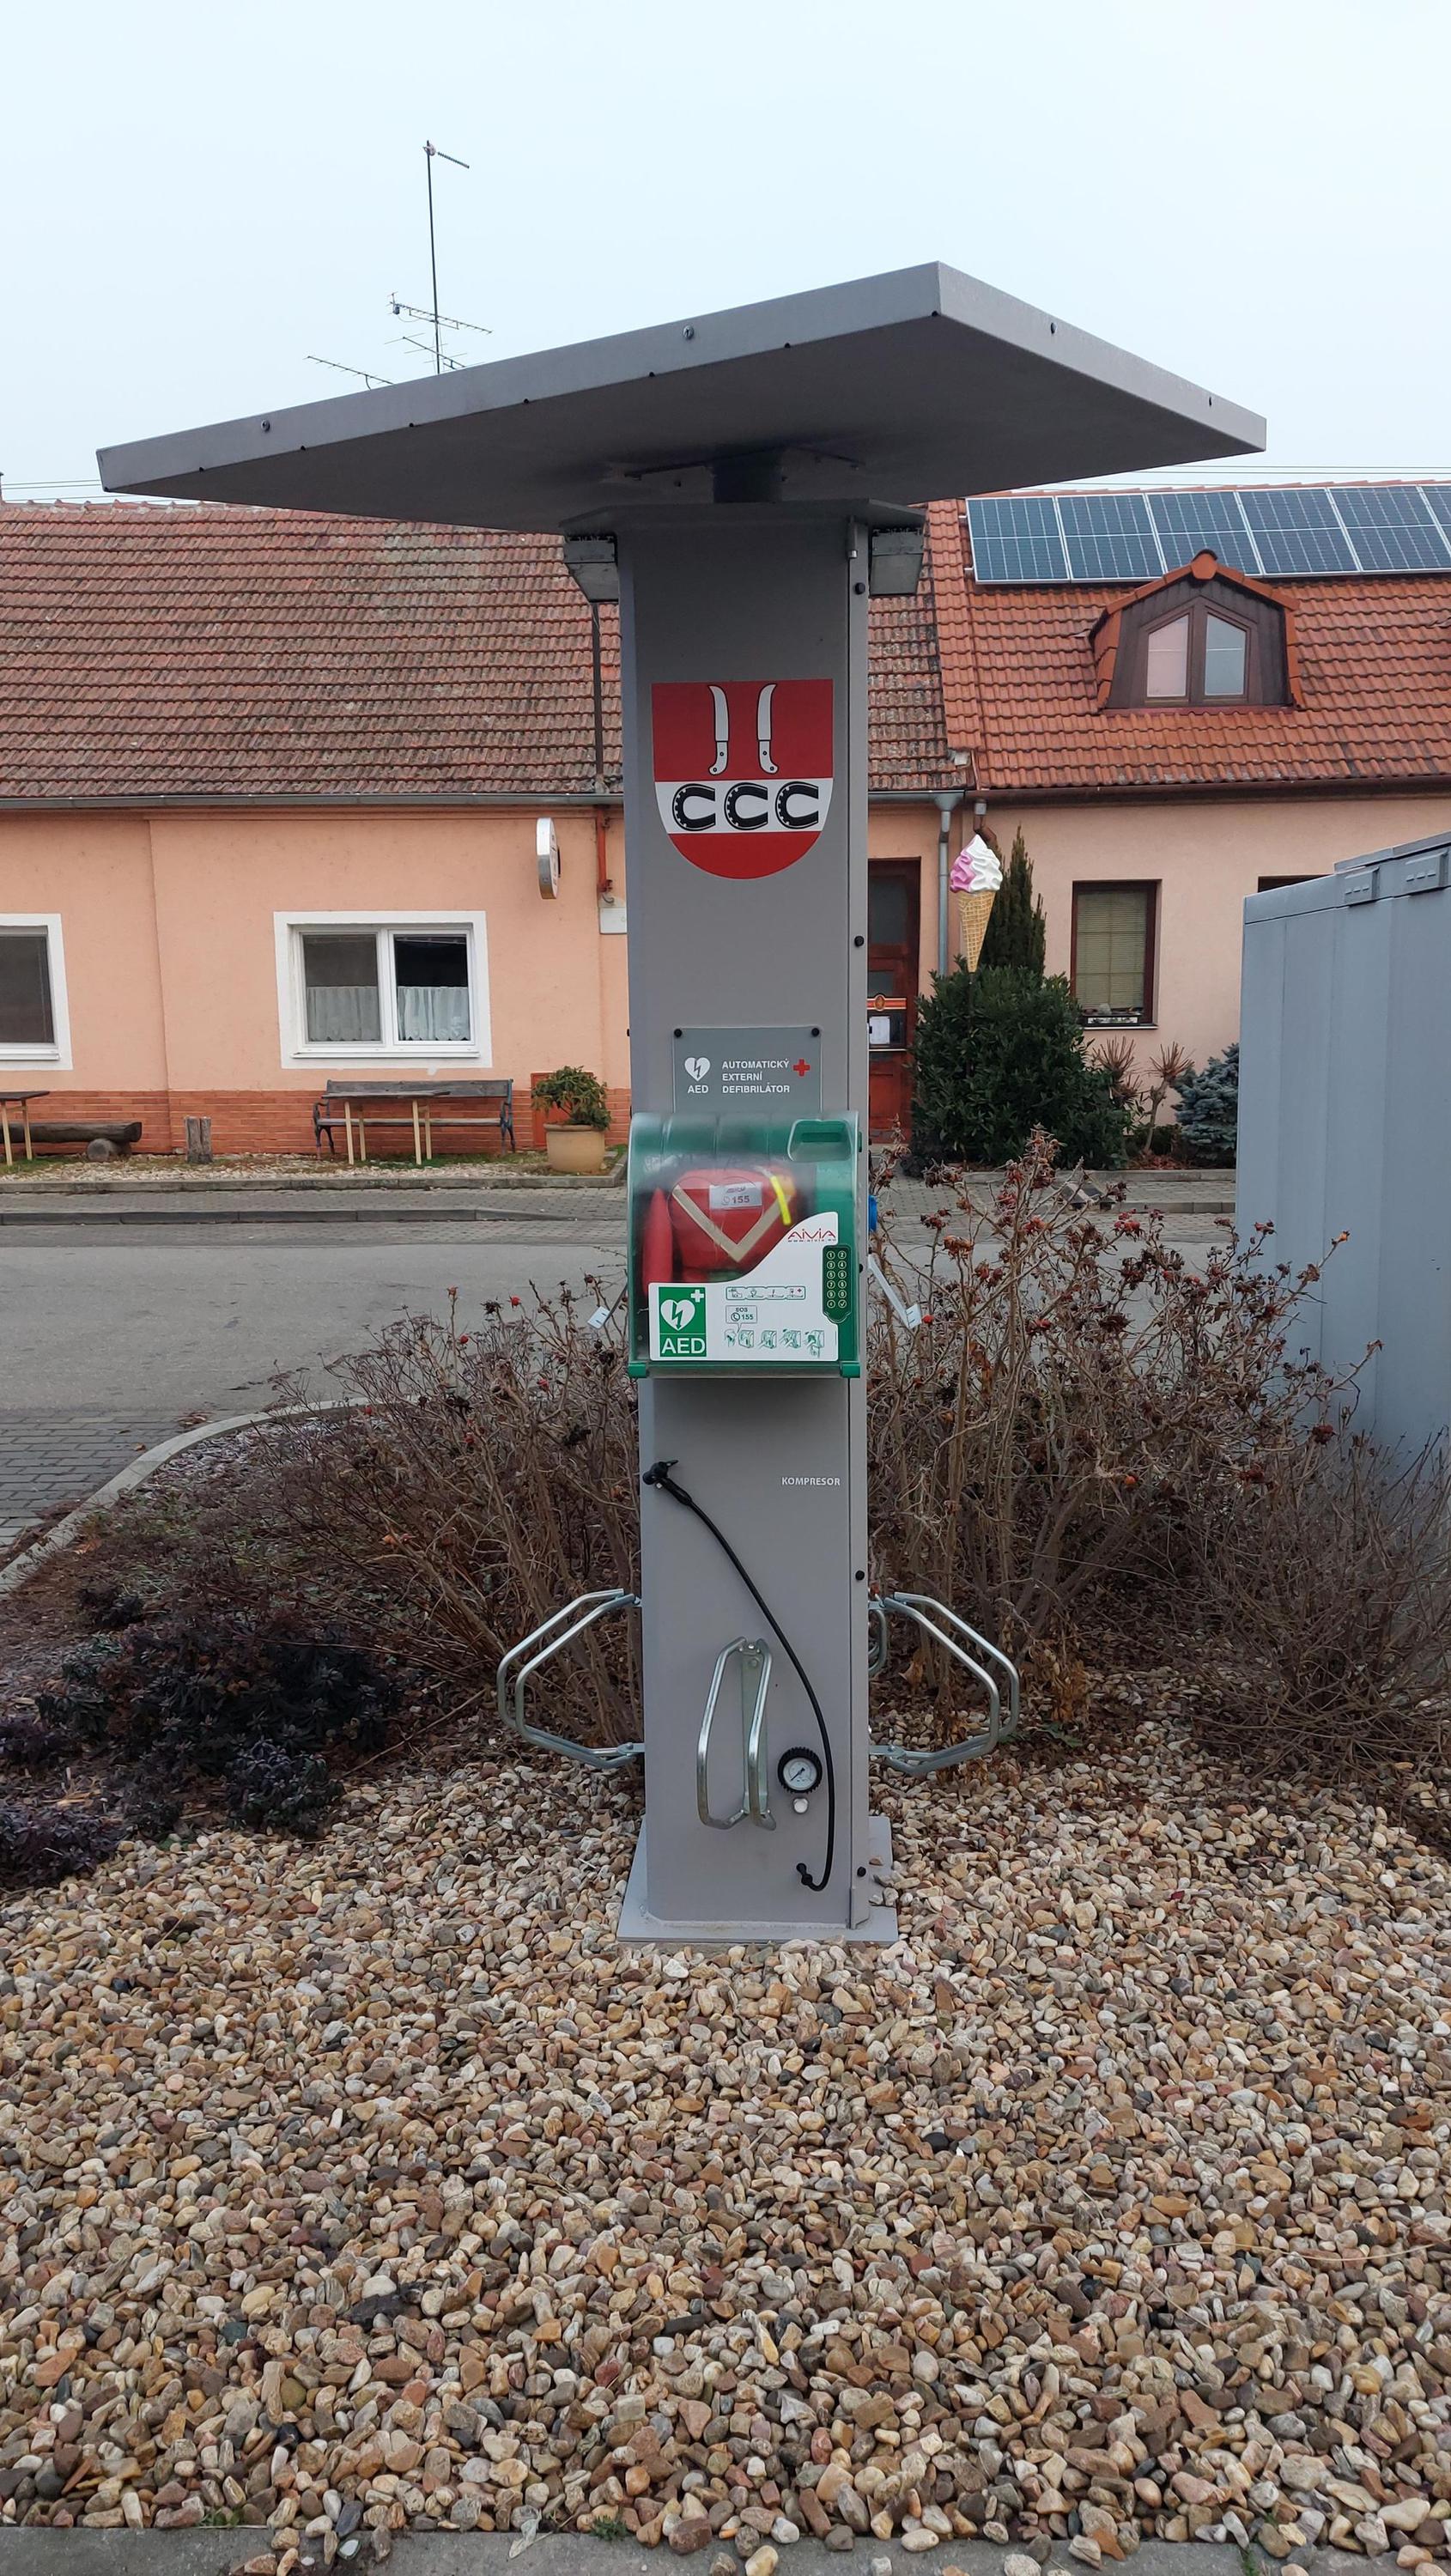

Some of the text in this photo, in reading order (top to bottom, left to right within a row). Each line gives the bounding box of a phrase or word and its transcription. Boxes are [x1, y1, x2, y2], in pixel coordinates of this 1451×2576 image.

[722, 1058, 790, 1069] AUTOMATICKÝ
[722, 1072, 762, 1081] EXTERNÍ
[687, 1085, 709, 1094] AED
[722, 1083, 790, 1093] DEFIBRILÁTOR
[732, 1195, 750, 1204] 155
[661, 1337, 706, 1354] AED
[781, 1476, 841, 1485] KOMPRESOR
